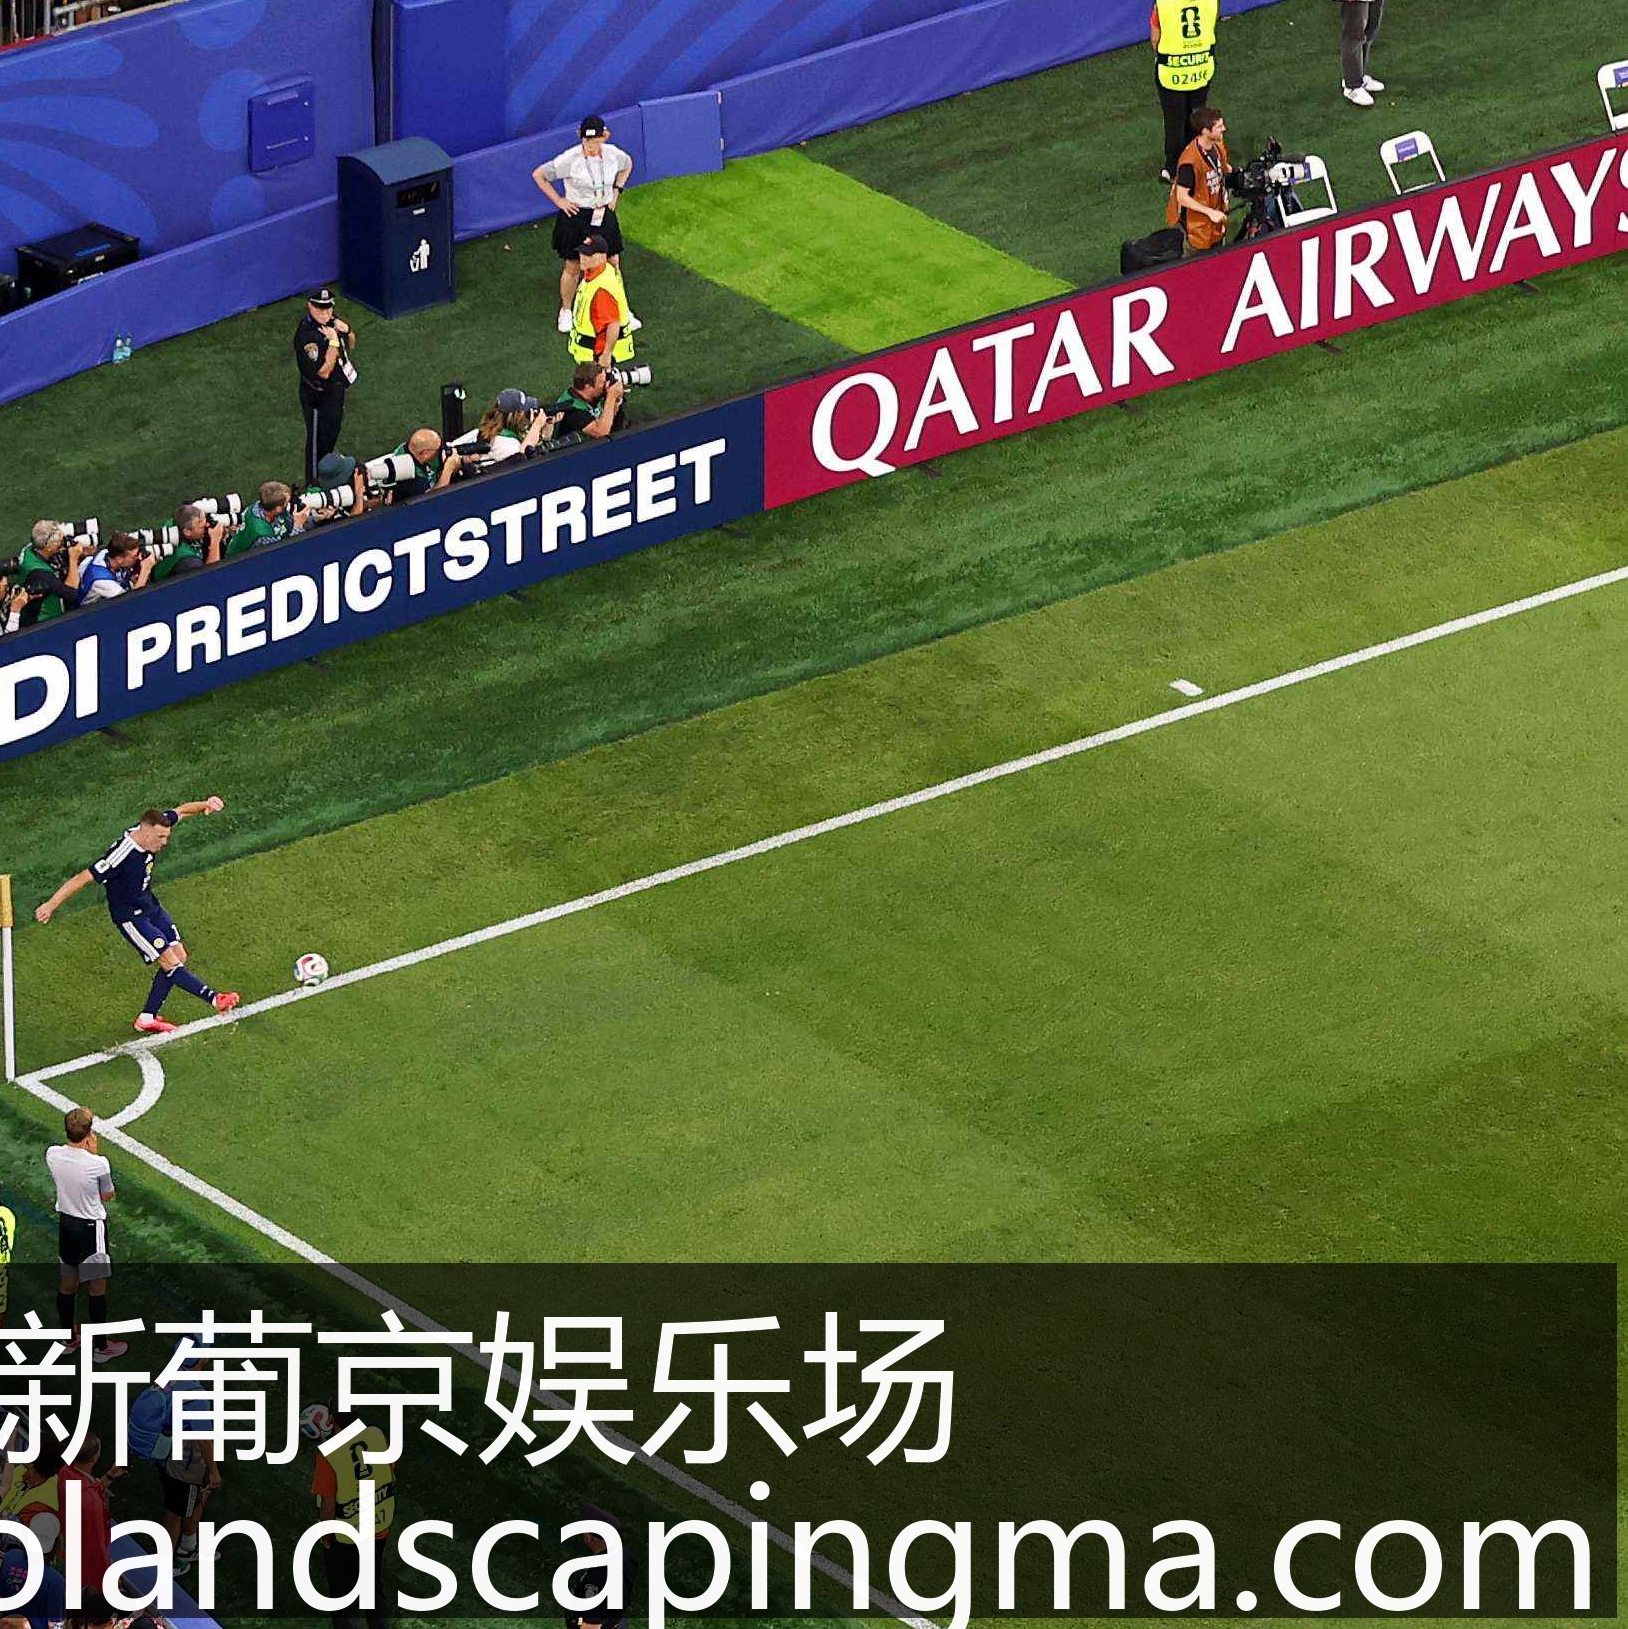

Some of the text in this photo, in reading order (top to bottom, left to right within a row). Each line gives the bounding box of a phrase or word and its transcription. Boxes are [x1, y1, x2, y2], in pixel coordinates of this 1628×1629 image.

[813, 148, 1628, 476] QATAR AIRWAY
[128, 438, 726, 690] PREDICTSTREET
